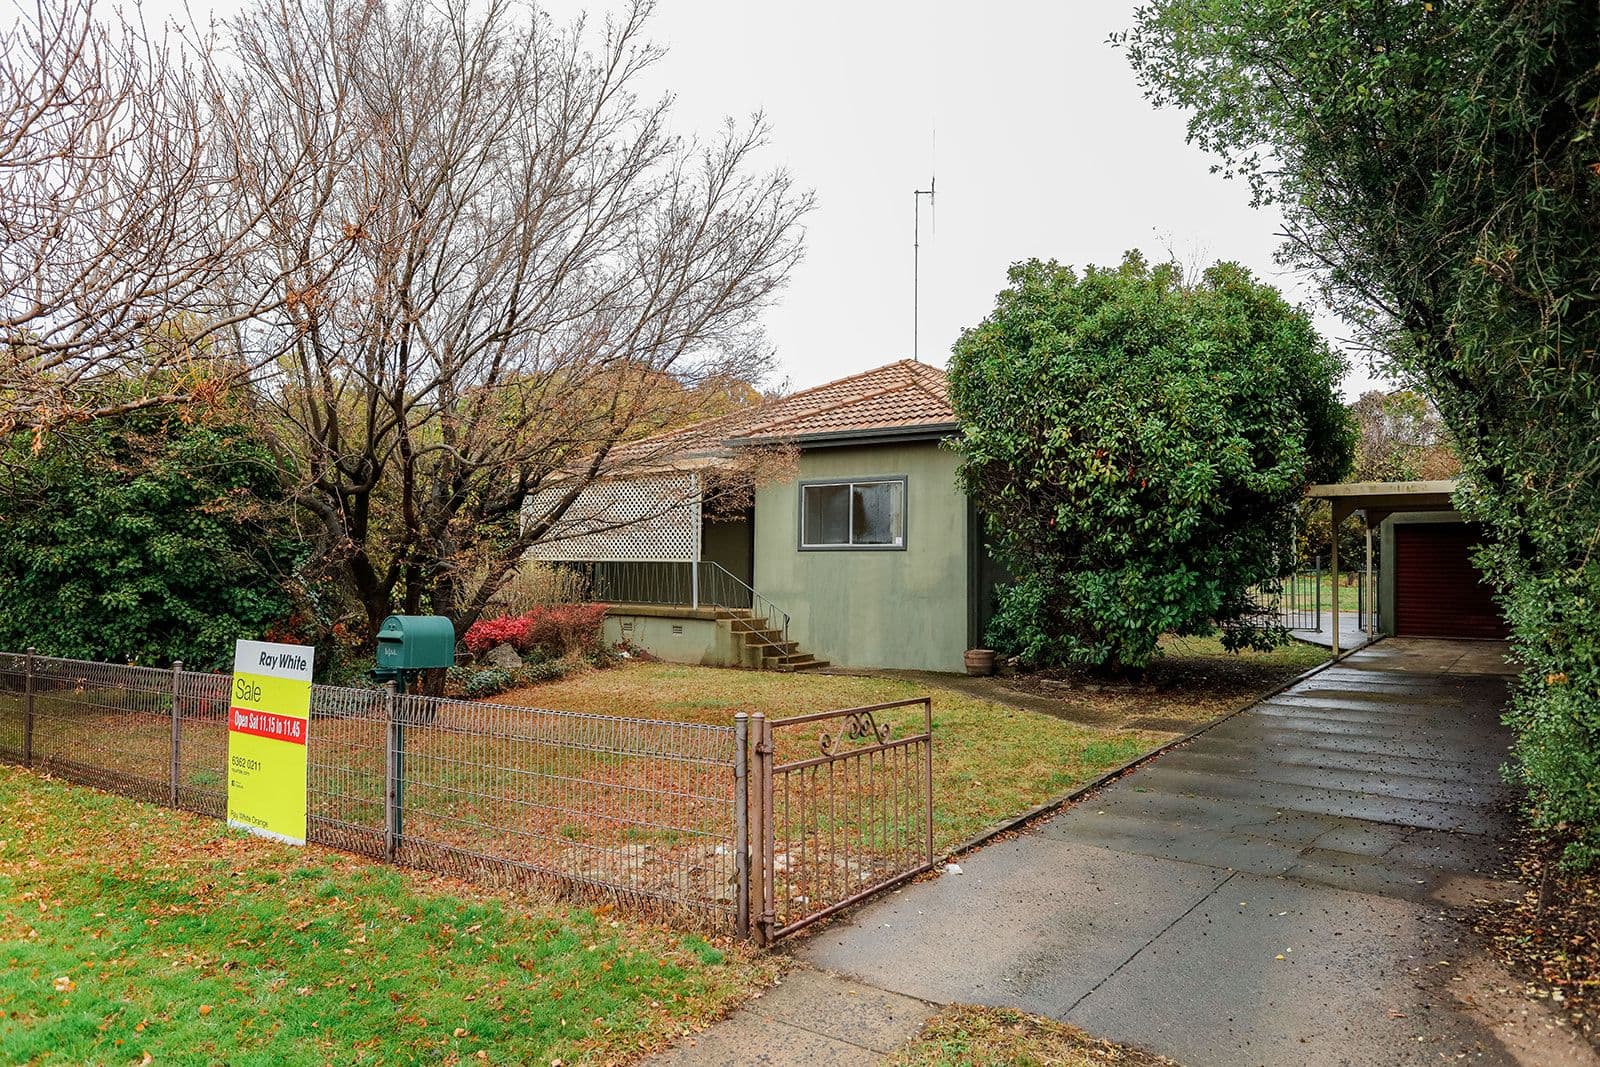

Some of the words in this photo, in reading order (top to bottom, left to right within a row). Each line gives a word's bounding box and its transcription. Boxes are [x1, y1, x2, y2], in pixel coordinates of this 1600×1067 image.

[259, 651, 278, 670] Ray
[279, 653, 307, 671] White
[236, 678, 261, 702] Sale
[235, 710, 248, 730] Open
[249, 712, 259, 730] Sat
[260, 715, 276, 733] 11.15
[283, 719, 300, 738] 11.45
